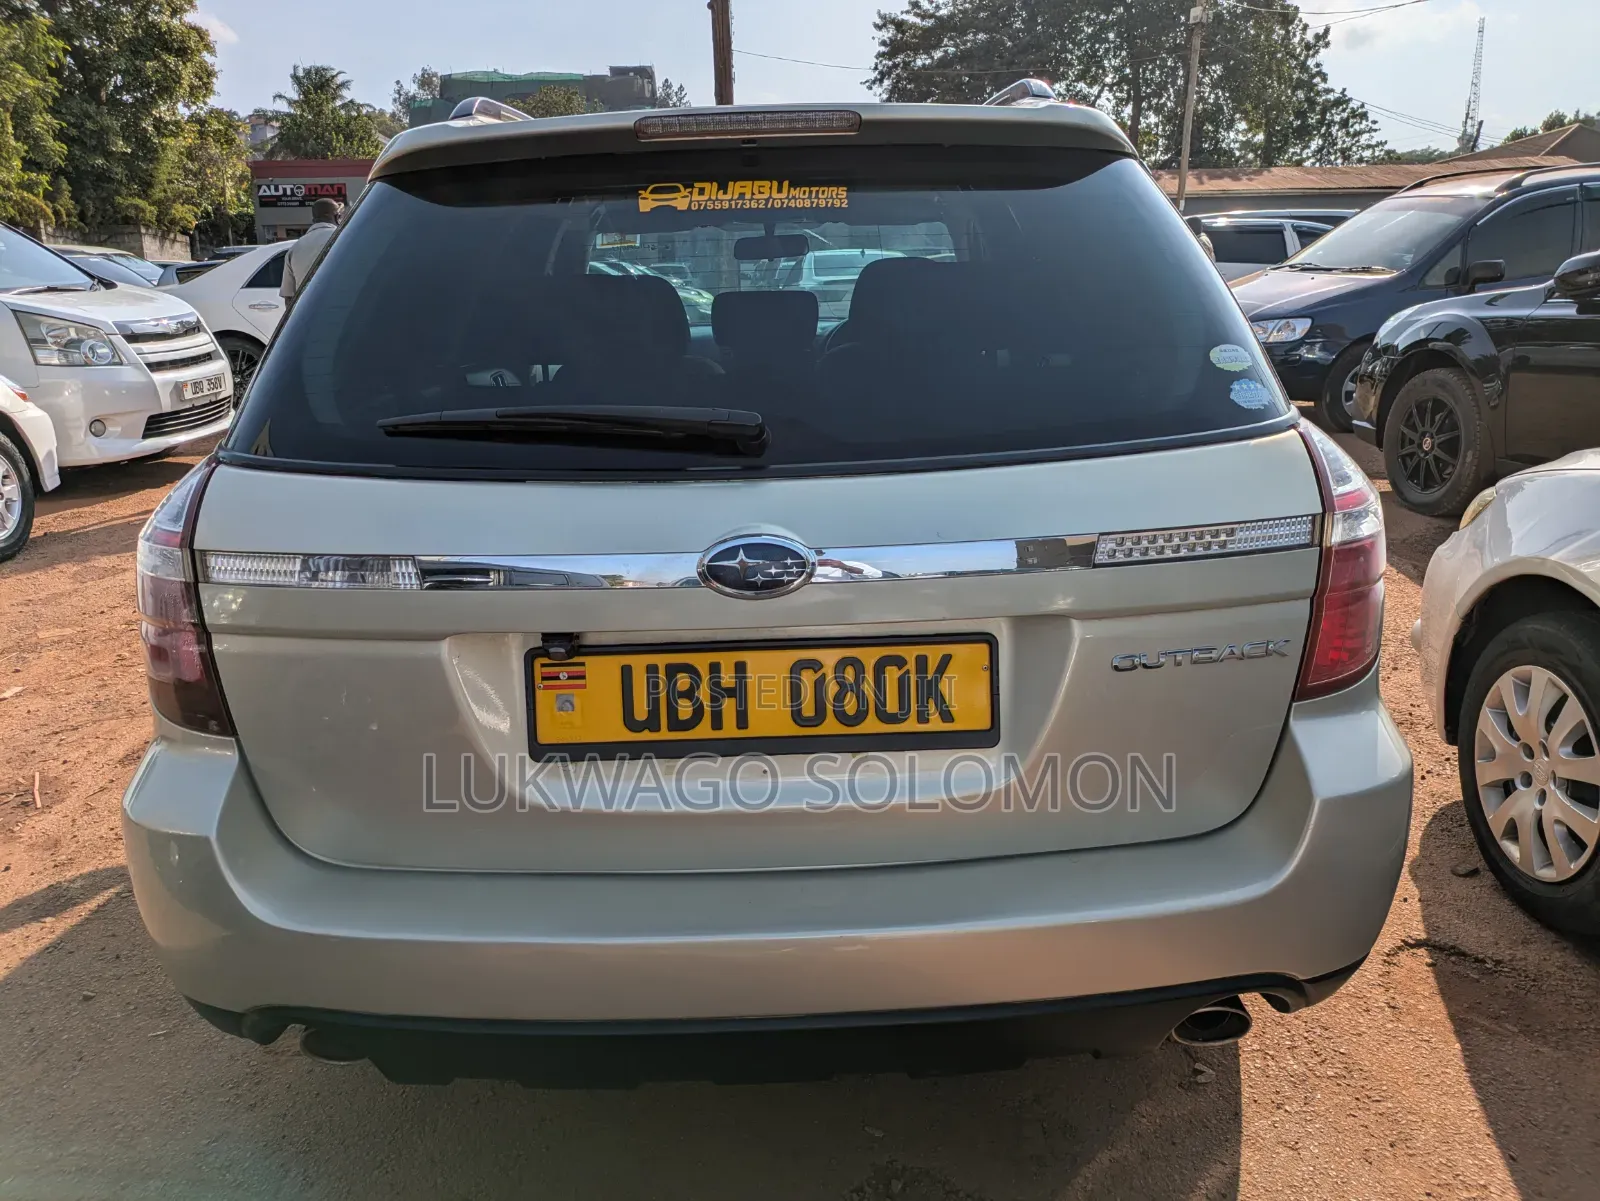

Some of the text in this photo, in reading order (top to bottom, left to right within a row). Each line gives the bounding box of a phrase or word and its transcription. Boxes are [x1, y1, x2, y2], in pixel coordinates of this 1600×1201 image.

[692, 181, 848, 200] DIJABU MOTORS
[691, 199, 848, 210] 0755917362/0740879792
[1111, 639, 1291, 672] OUTBACK
[621, 653, 955, 733] UBH 080K
